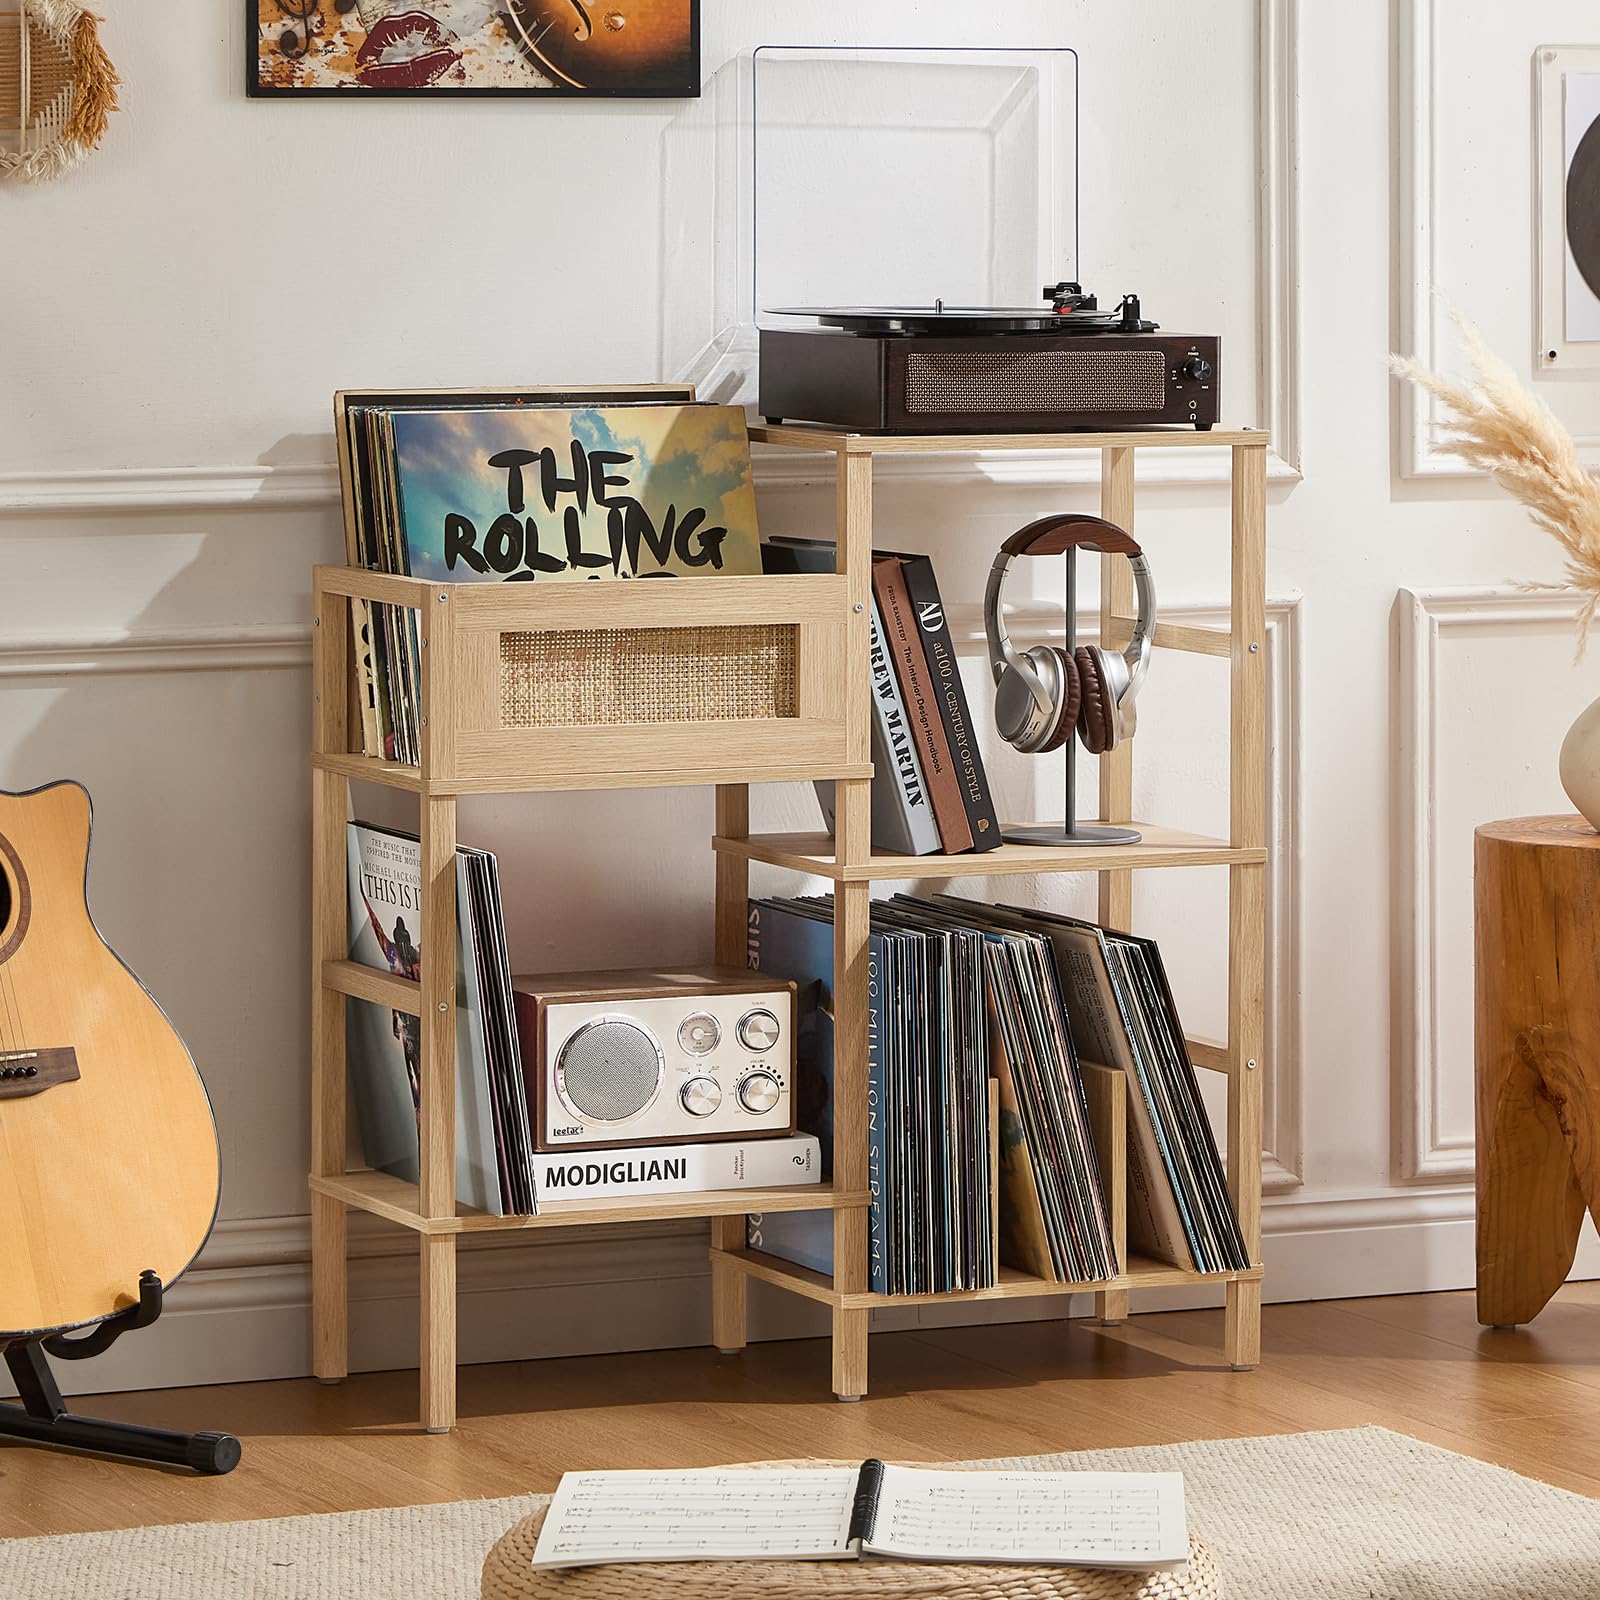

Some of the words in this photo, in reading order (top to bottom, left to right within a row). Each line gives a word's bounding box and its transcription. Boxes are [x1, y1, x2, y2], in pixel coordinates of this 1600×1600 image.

[488, 439, 637, 517] THE
[444, 504, 728, 578] ROLLING
[887, 585, 896, 606] FRIDA
[892, 606, 907, 642] RAMSTEDT
[917, 601, 944, 632] AD
[903, 646, 912, 664] The
[907, 664, 921, 697] Interior
[943, 681, 953, 690] A
[871, 614, 896, 701] DREW
[884, 708, 925, 808] MARTIN
[916, 699, 929, 729] Design
[946, 691, 968, 748] CENTURY
[925, 729, 943, 775] Handbook
[960, 749, 972, 767] OF
[964, 766, 982, 802] STYLE
[371, 838, 381, 848] THE
[383, 841, 400, 853] MUSIC
[402, 846, 416, 857] THAT
[392, 853, 402, 863] THE
[363, 861, 391, 878] MICHAEL
[365, 874, 397, 905] THIS
[398, 883, 412, 909] IS
[414, 887, 421, 911] I
[869, 1009, 878, 1131] MILLION
[545, 1158, 686, 1188] MODIGLIANI
[870, 1145, 882, 1278] STREAMS
